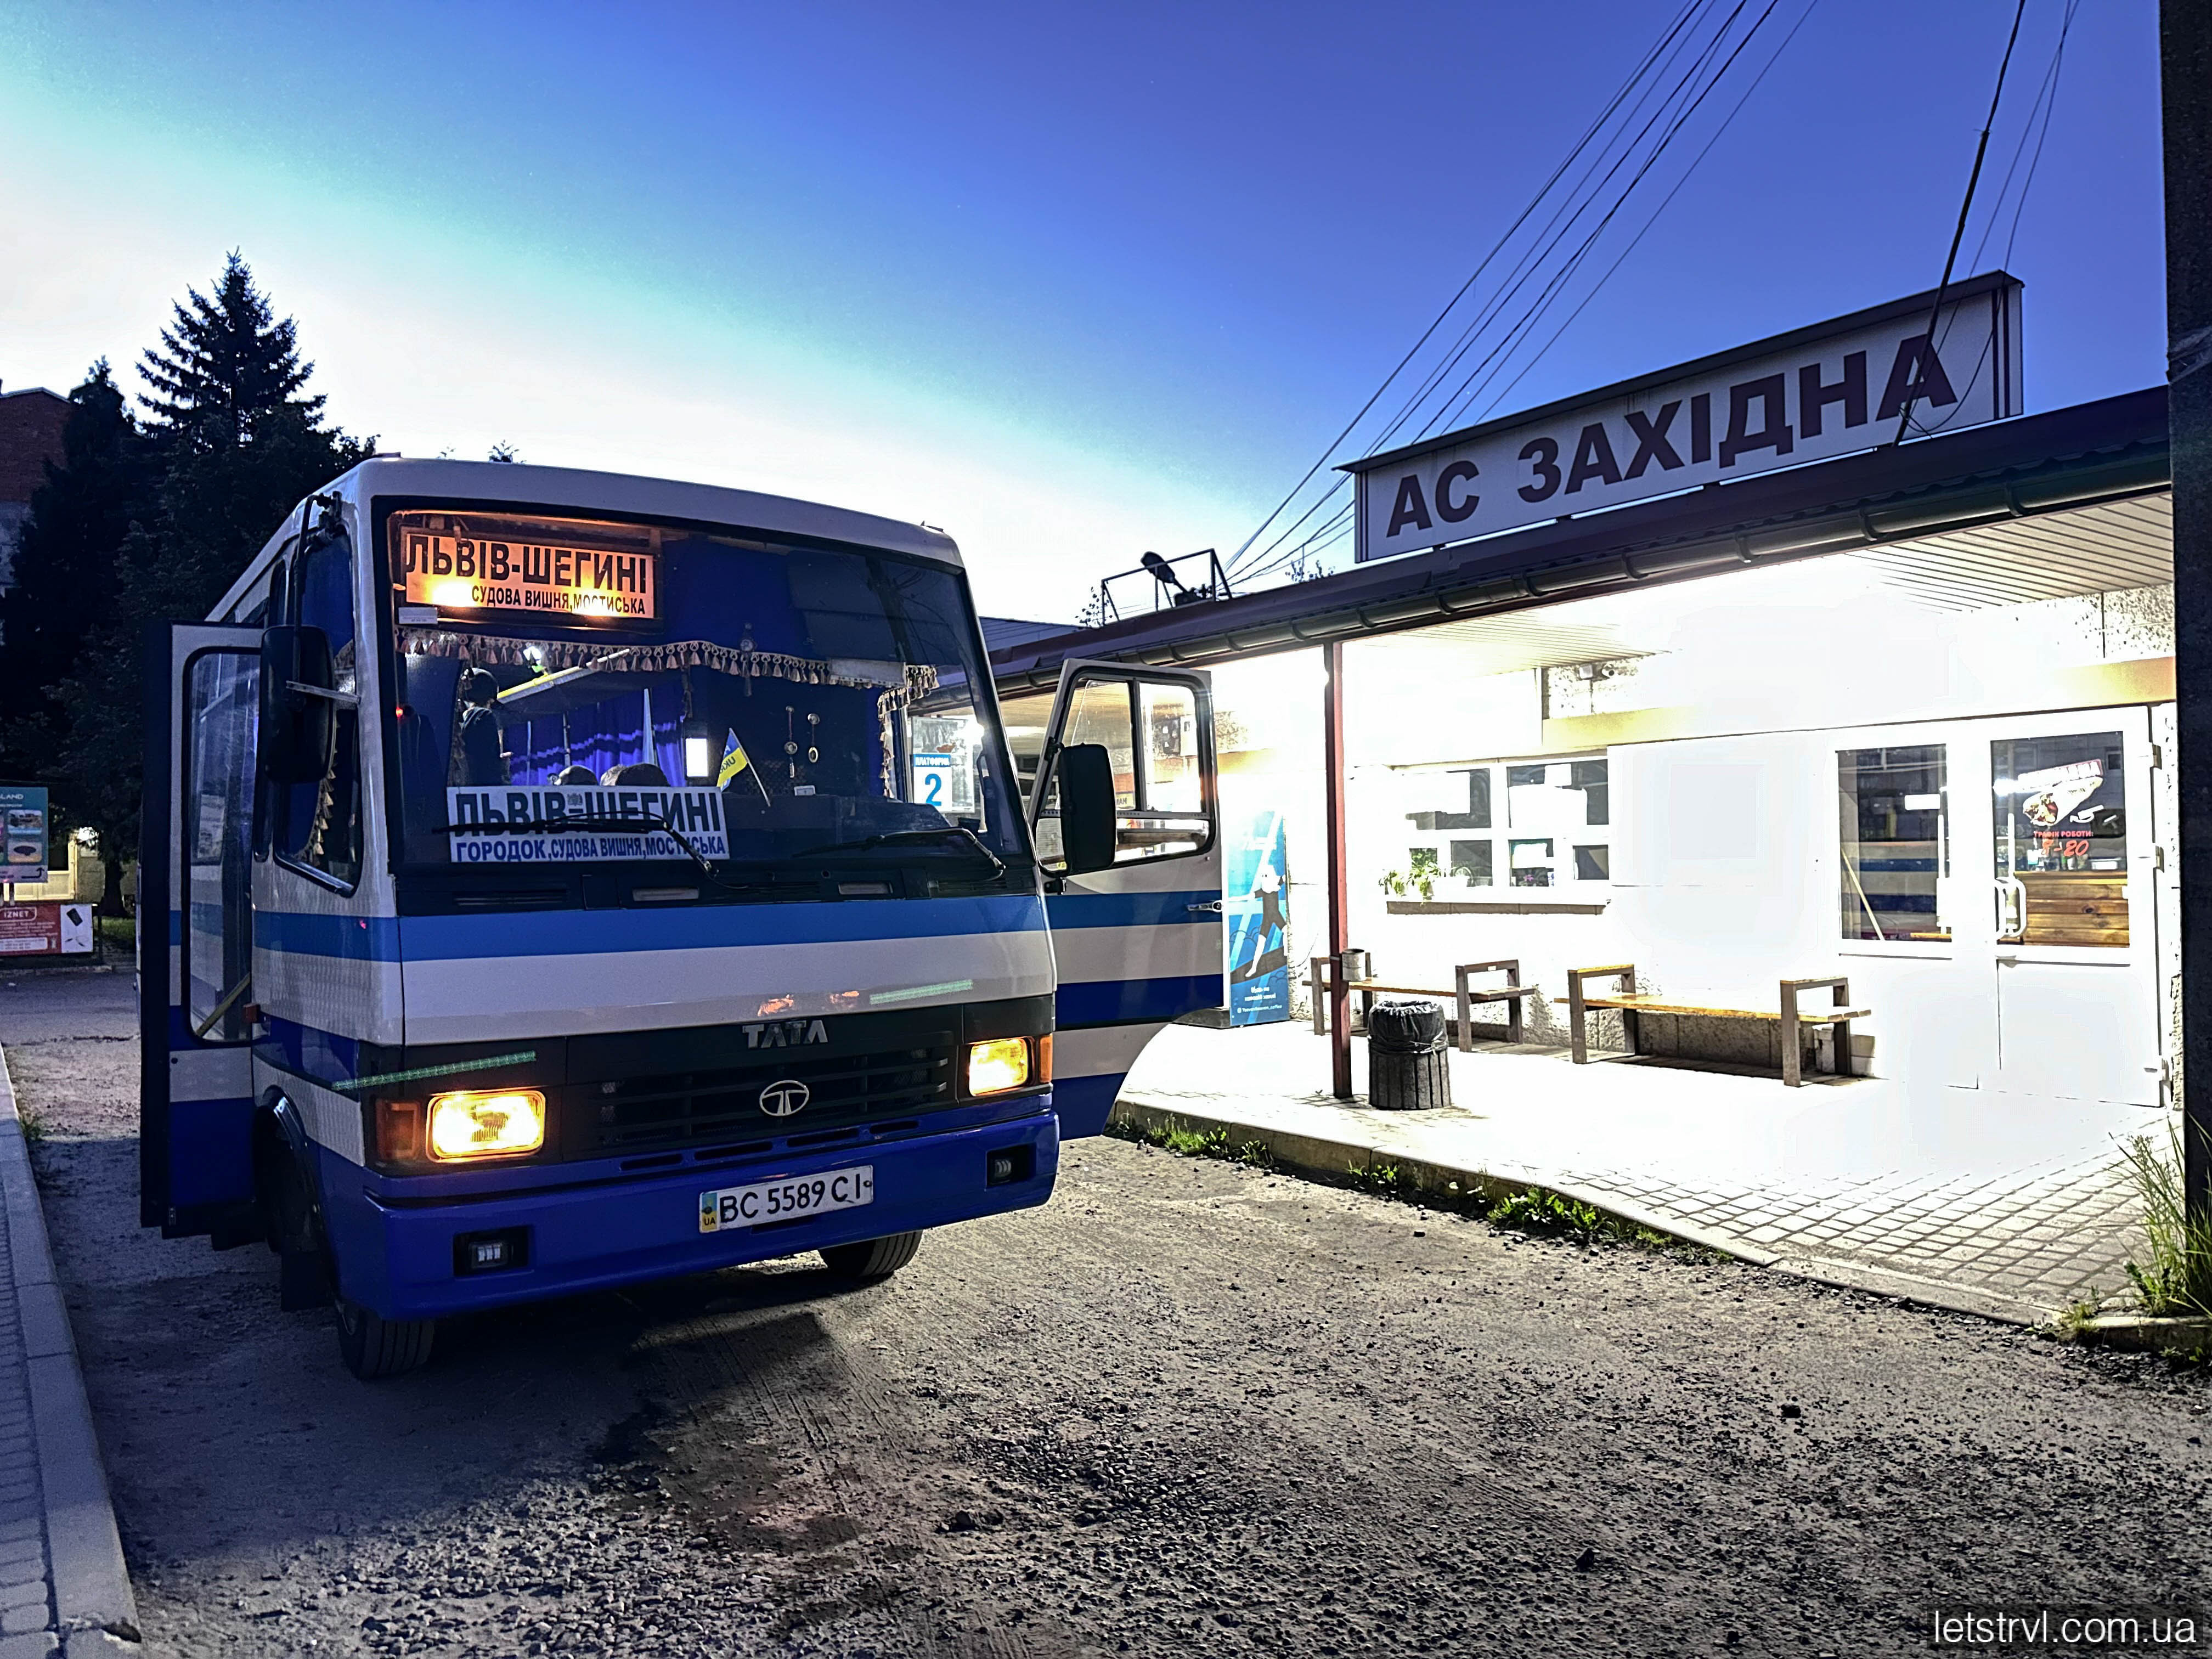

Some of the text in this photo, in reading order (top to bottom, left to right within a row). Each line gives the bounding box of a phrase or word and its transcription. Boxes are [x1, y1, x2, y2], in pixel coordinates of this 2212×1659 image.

[1386, 334, 1958, 538] АС ЗАХІДНА
[406, 535, 646, 594] ЛЬВІВ-ШЕГИНІ
[472, 585, 521, 607] СУДОВА
[924, 773, 943, 806] 2
[742, 1019, 828, 1049] TATA
[719, 1191, 759, 1223] BC
[766, 1180, 826, 1215] 5589
[703, 1216, 716, 1226] UA
